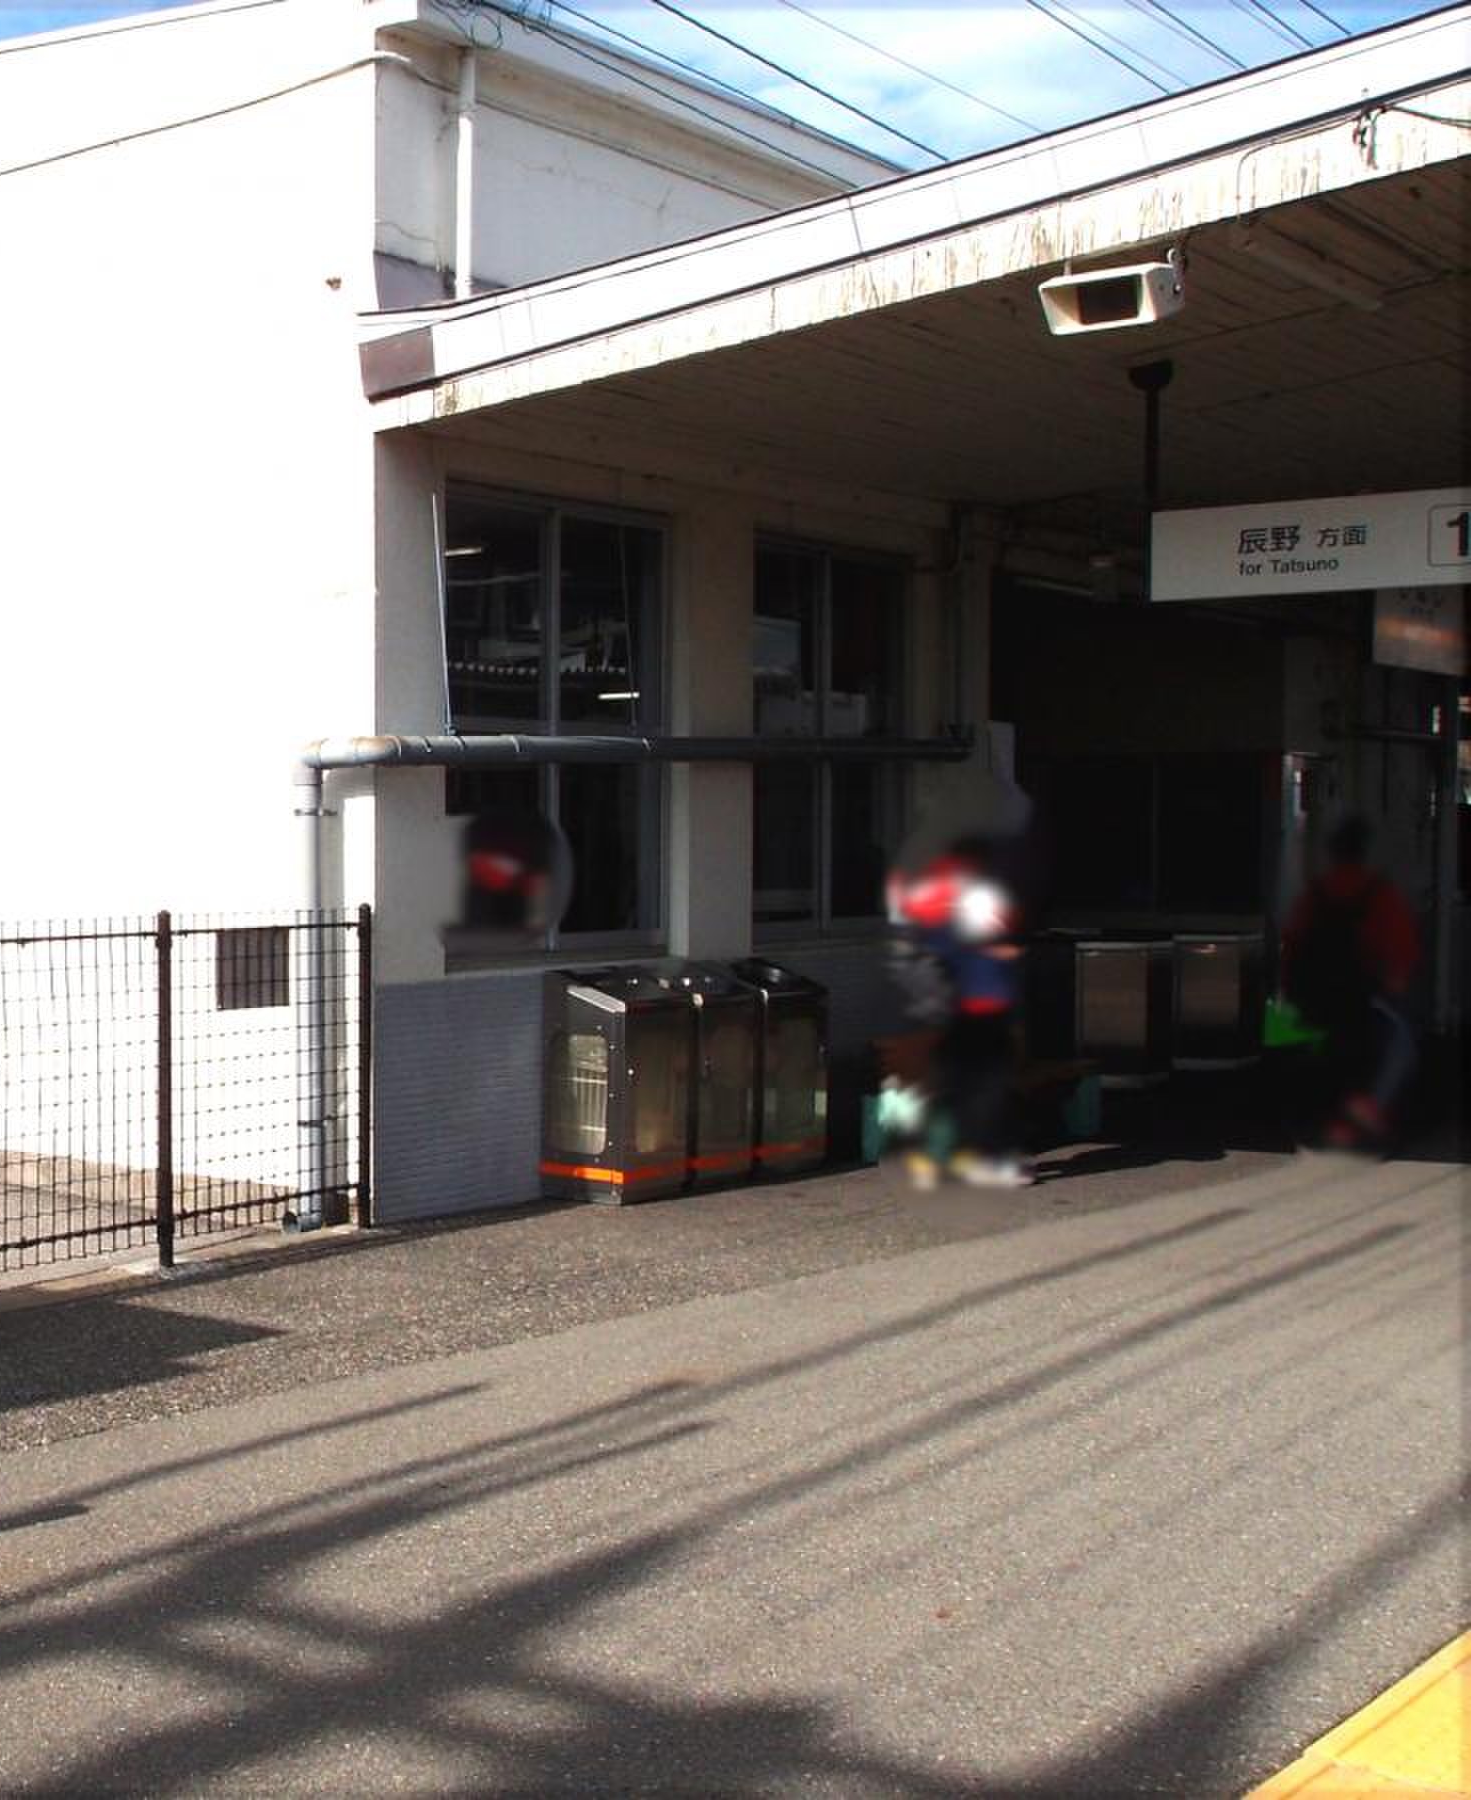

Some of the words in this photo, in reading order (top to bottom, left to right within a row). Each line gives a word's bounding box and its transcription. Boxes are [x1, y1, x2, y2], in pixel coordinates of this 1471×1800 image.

[1238, 525, 1300, 554] 辰野
[1316, 525, 1367, 548] 方面
[1447, 511, 1469, 557] 1
[1239, 561, 1262, 576] for
[1271, 557, 1339, 575] Tatsuno
